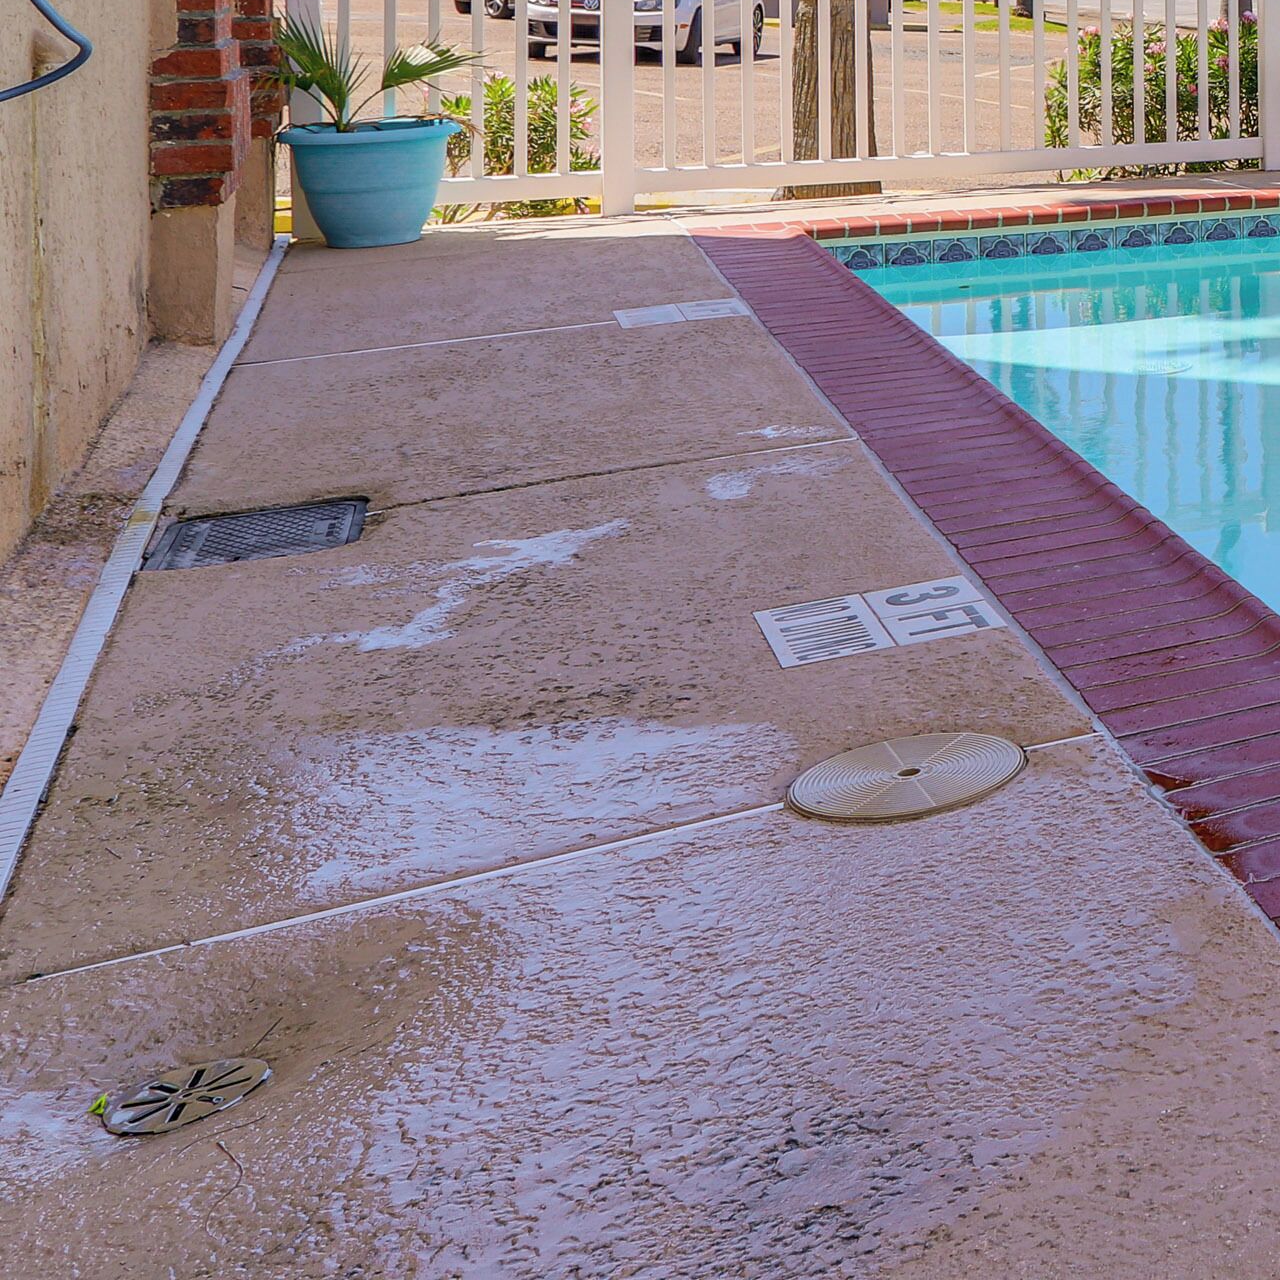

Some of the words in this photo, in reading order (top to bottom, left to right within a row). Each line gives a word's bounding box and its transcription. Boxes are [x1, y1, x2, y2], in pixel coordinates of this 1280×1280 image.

[885, 585, 960, 606] 3
[769, 598, 851, 622] NO
[898, 604, 991, 636] FT
[779, 614, 877, 662] DIVING
